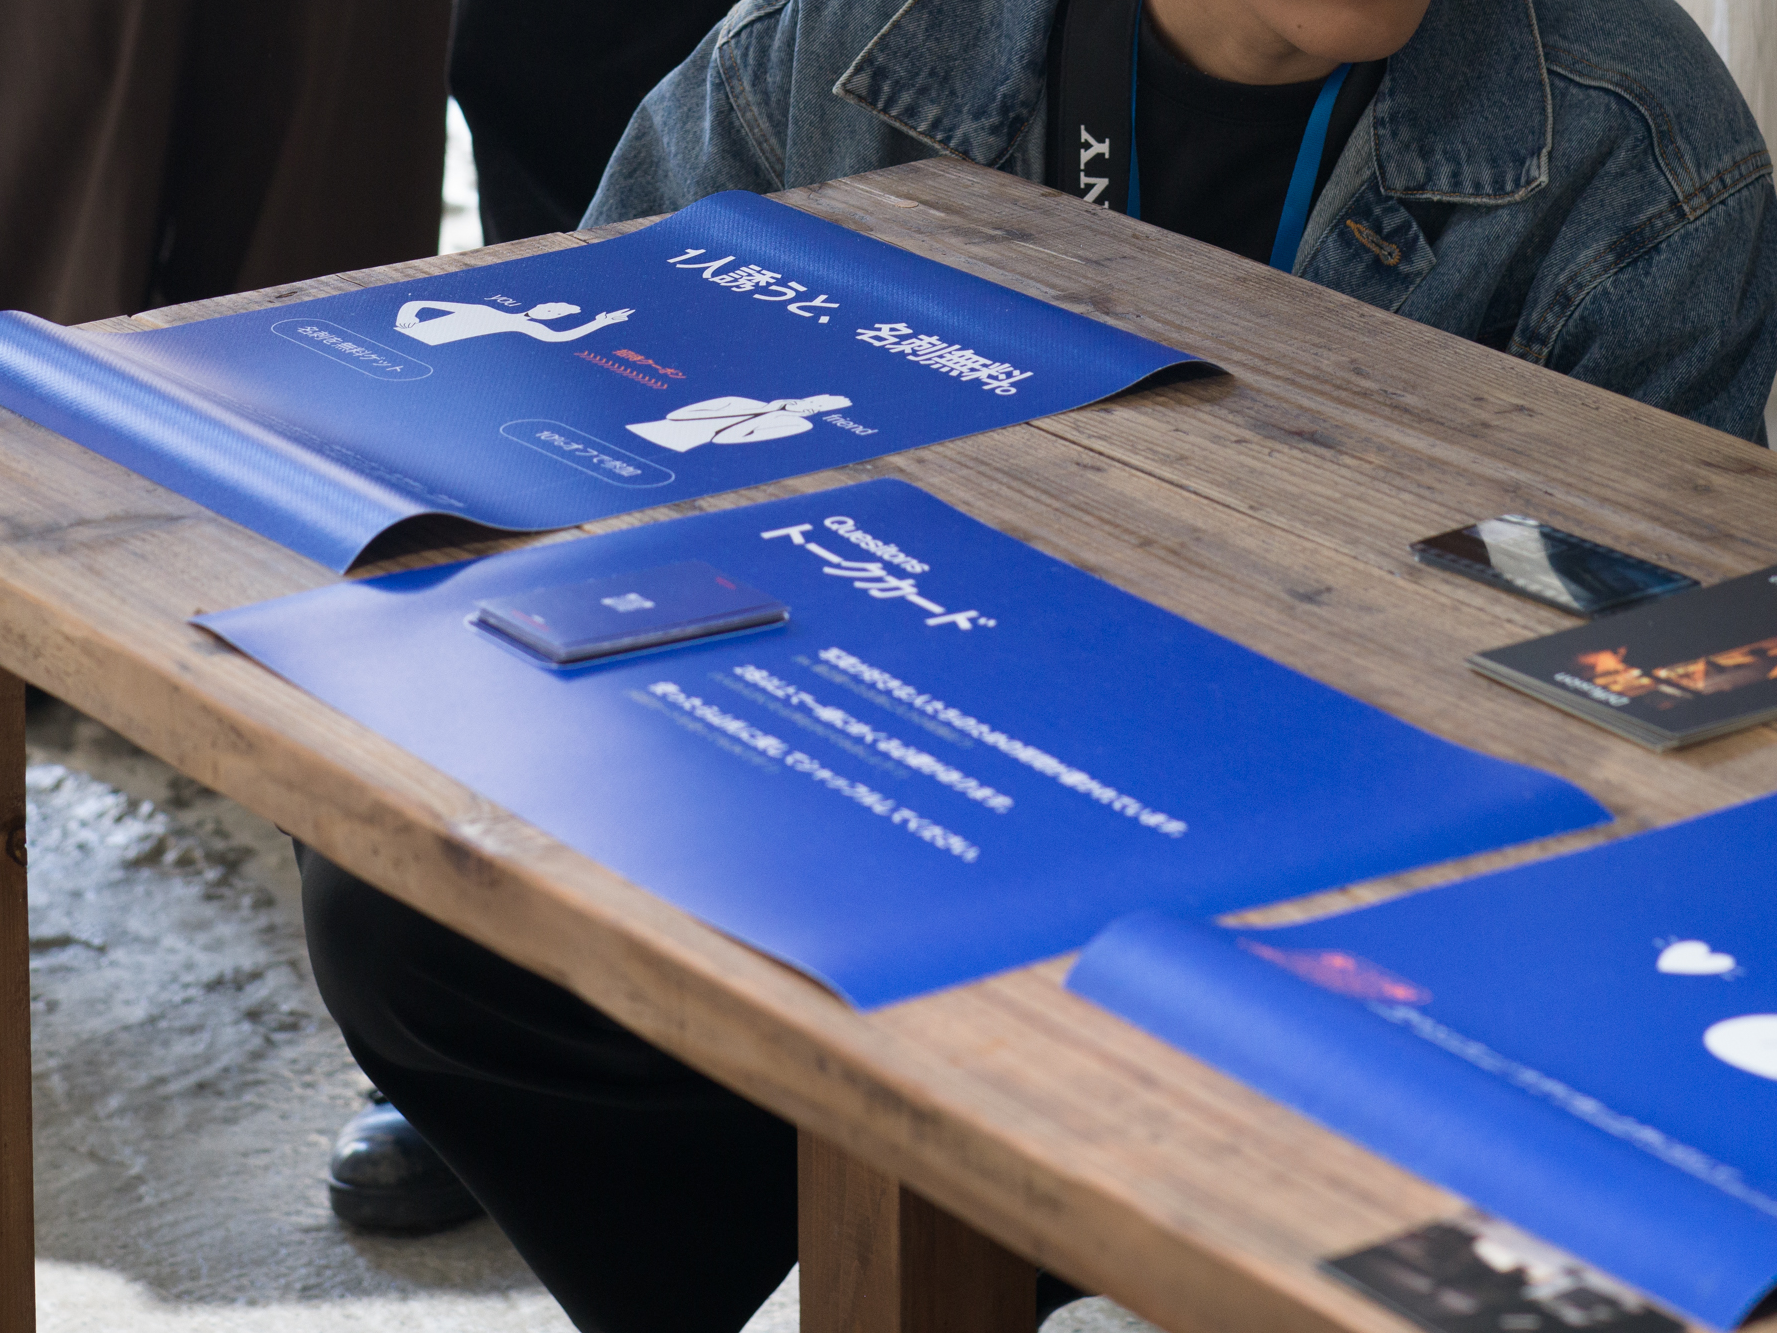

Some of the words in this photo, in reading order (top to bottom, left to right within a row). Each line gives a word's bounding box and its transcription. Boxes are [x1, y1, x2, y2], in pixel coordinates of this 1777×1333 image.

[1080, 124, 1110, 209] NY
[483, 293, 523, 309] you
[297, 326, 404, 372] 名刺を無料ゲット
[823, 413, 879, 436] friend
[760, 523, 997, 630] トークカード
